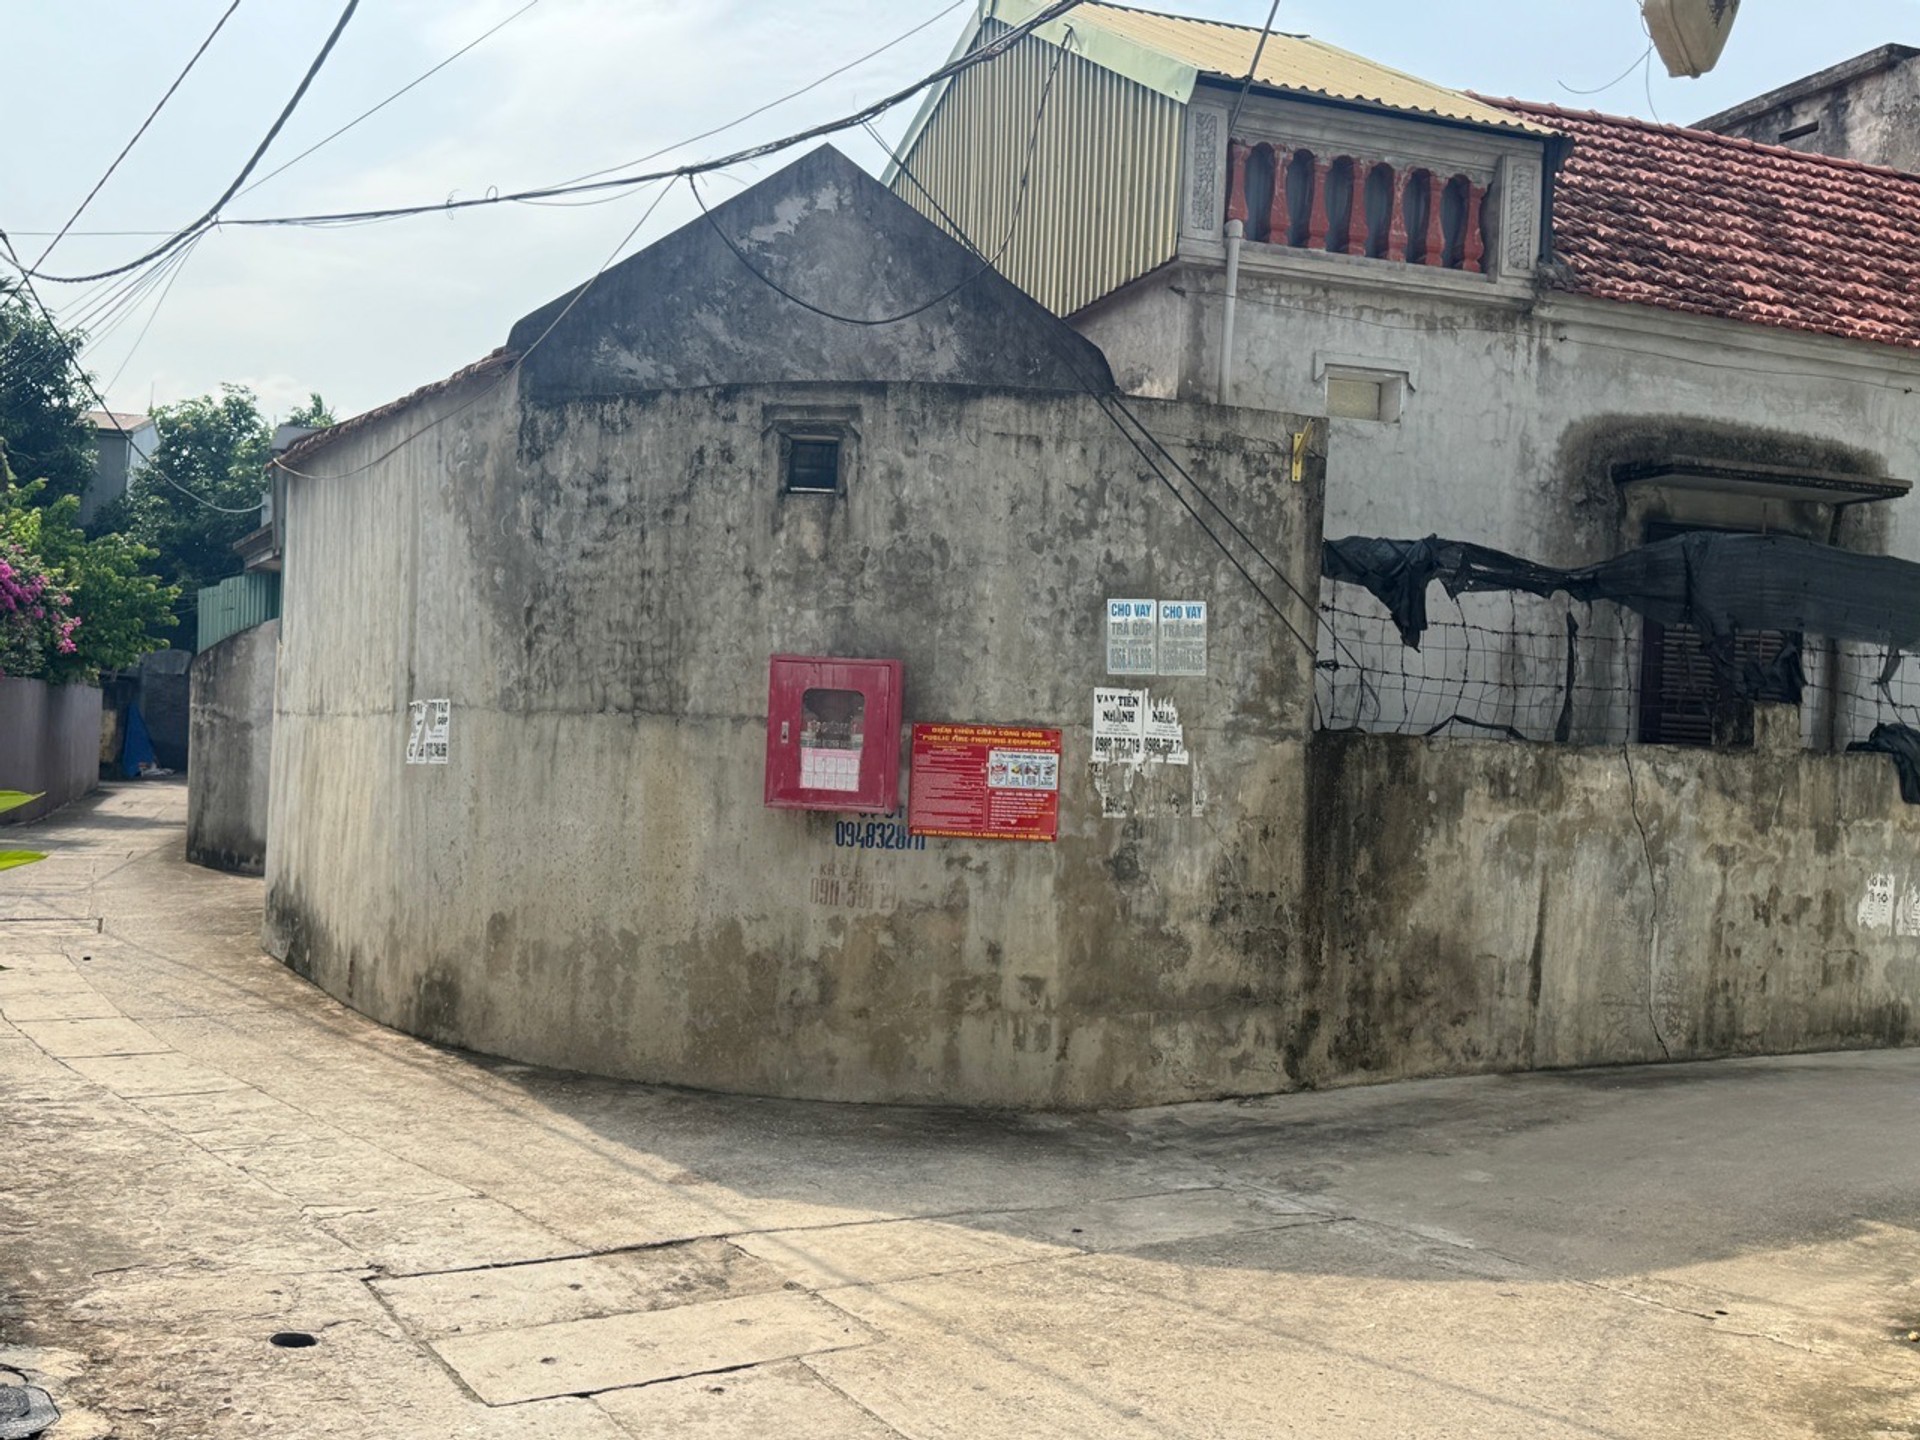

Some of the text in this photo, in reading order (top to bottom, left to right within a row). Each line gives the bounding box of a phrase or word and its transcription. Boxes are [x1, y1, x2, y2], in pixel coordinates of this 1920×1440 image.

[1111, 603, 1152, 617] CHO VAY
[1162, 605, 1203, 619] CHO VAY
